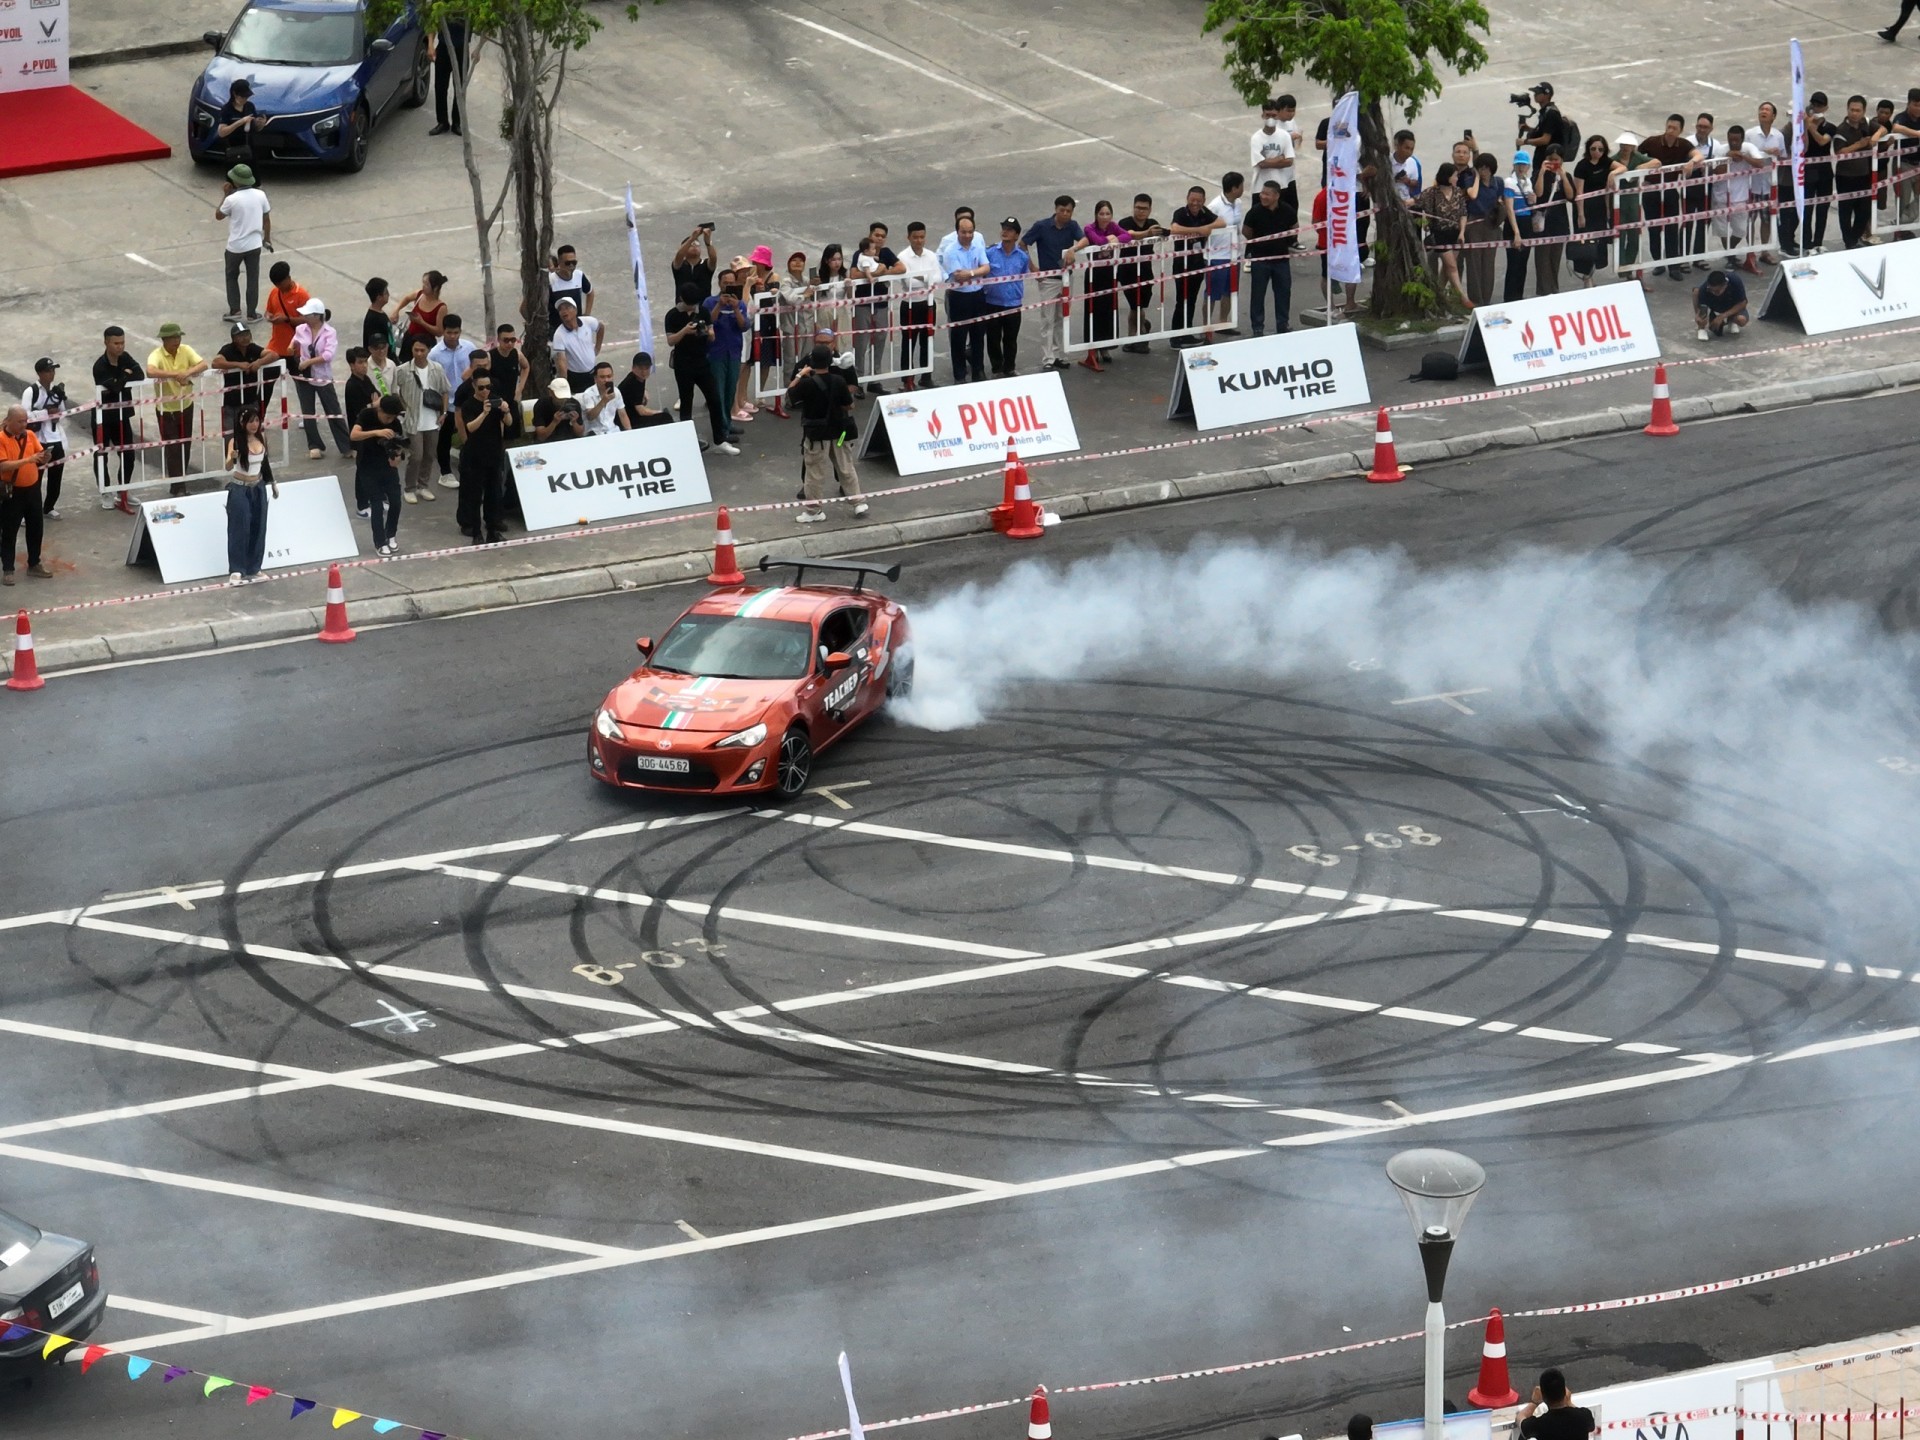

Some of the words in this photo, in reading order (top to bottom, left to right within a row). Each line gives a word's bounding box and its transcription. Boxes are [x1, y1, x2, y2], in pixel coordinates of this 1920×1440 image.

[33, 58, 57, 70] PVOIL
[1861, 302, 1908, 316] VINFAST
[1549, 304, 1632, 350] PVOIL
[1513, 347, 1554, 362] PETROVIETNAM
[1589, 349, 1598, 357] xa
[1218, 358, 1333, 394] KUMHO
[1283, 379, 1337, 400] TIRE
[958, 395, 1048, 440] PVOIL
[918, 436, 963, 451] PETROVIETNAM
[968, 440, 1000, 452] Đường
[1014, 435, 1034, 446] hêm
[933, 448, 954, 458] PVOIL
[547, 457, 672, 493] KUMHO
[618, 478, 676, 499] TIRE
[638, 756, 688, 773] 30G-445.62
